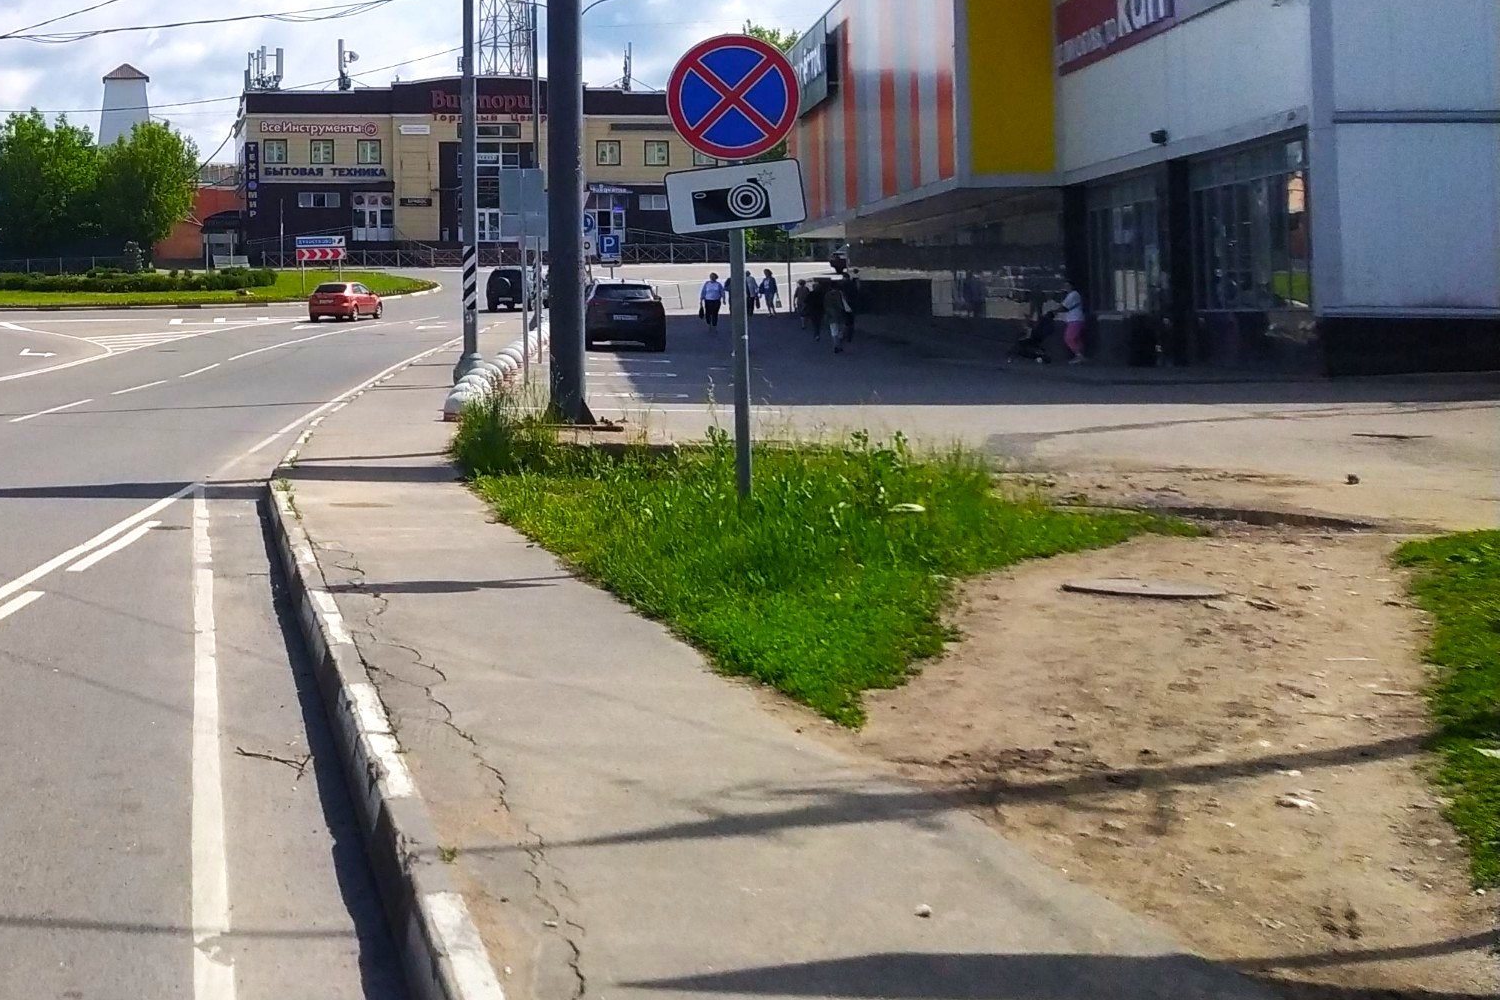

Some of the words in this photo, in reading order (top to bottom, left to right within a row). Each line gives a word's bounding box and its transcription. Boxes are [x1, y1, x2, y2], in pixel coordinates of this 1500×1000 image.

[431, 89, 544, 112] Витори
[264, 167, 324, 177] БЫТОВАЯ
[331, 167, 387, 178] ТЕХНИКА
